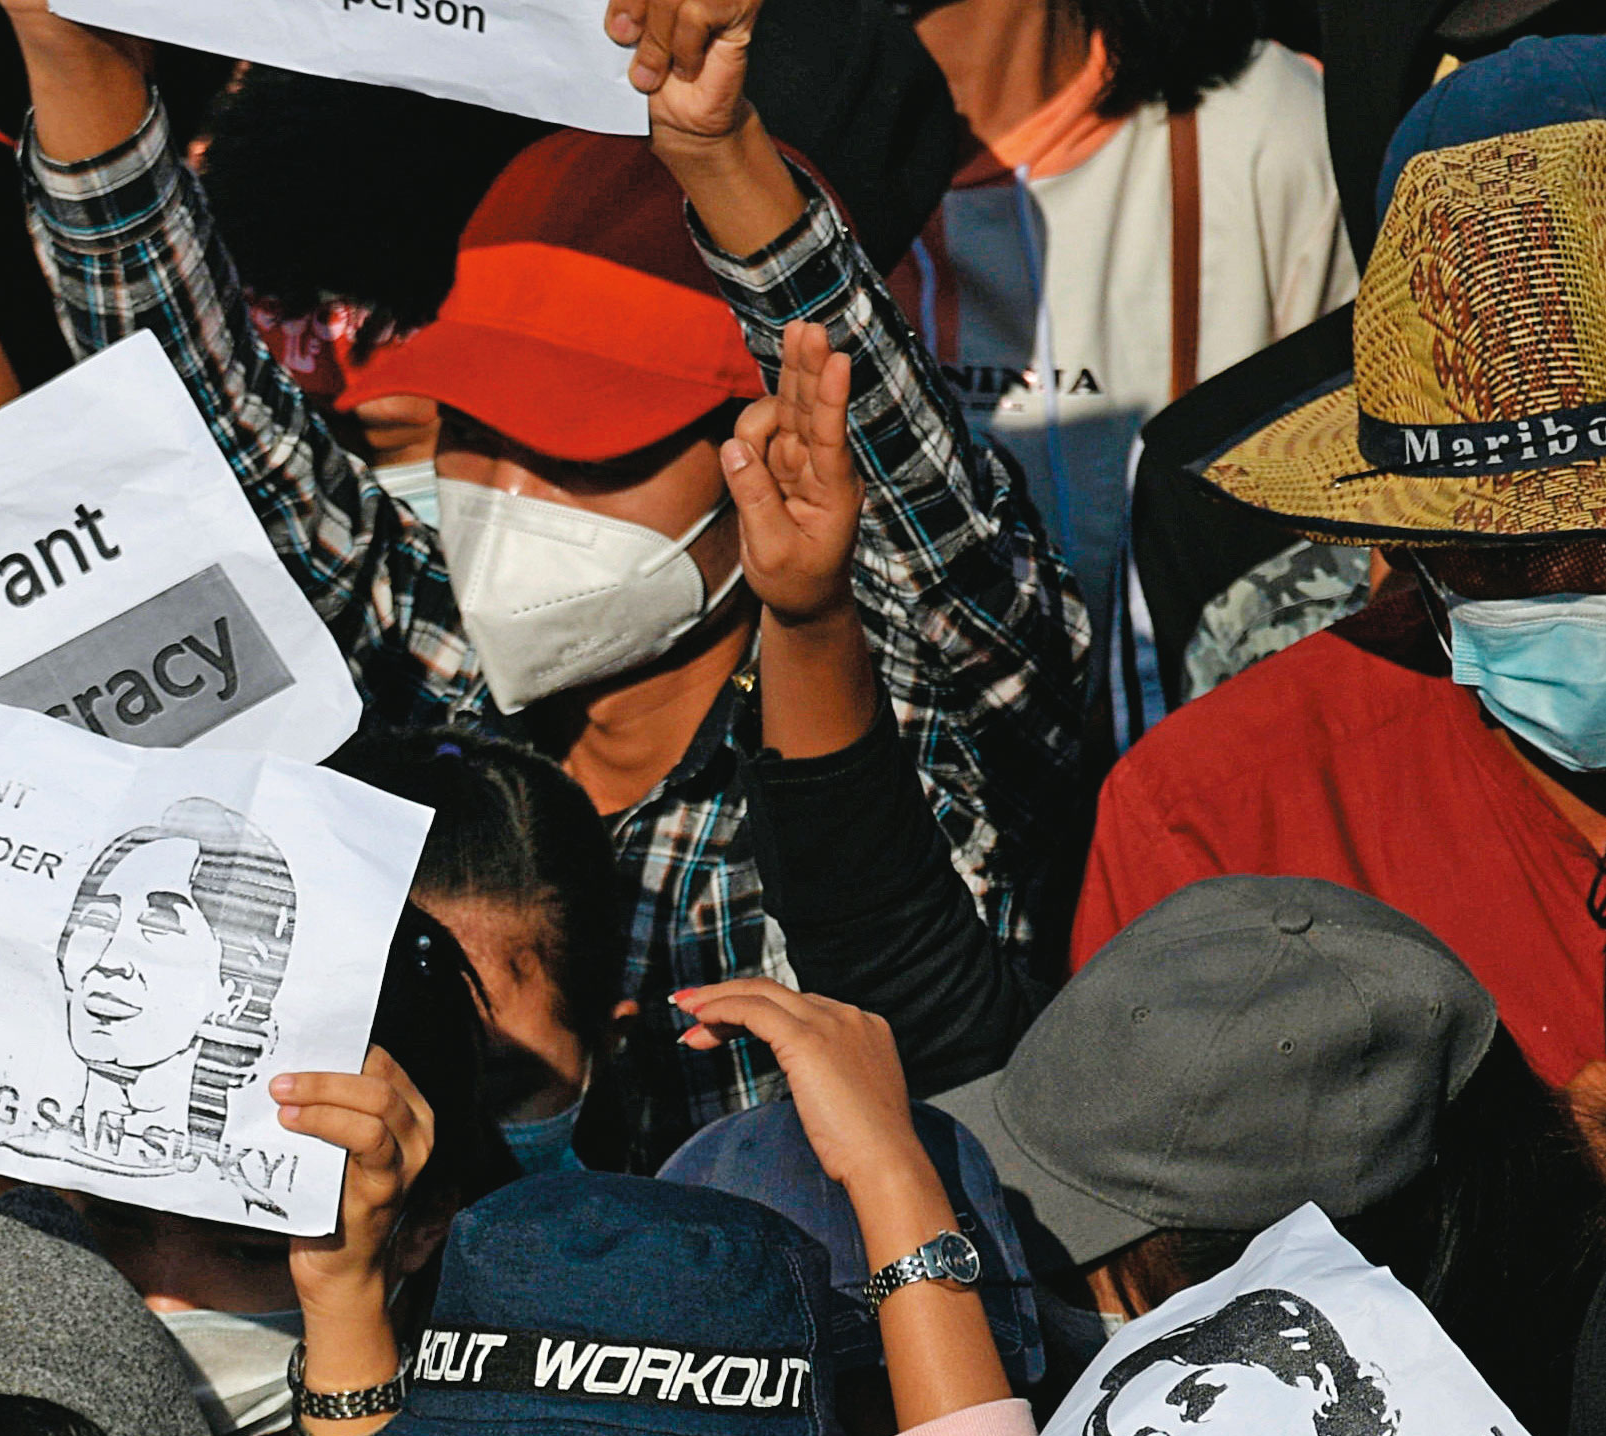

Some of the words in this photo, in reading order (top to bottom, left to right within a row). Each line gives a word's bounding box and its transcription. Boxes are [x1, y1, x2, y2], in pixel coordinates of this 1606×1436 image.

[32, 1098, 126, 1156] SAN
[219, 1143, 299, 1192] KYI
[533, 1336, 811, 1411] WORKOUT
